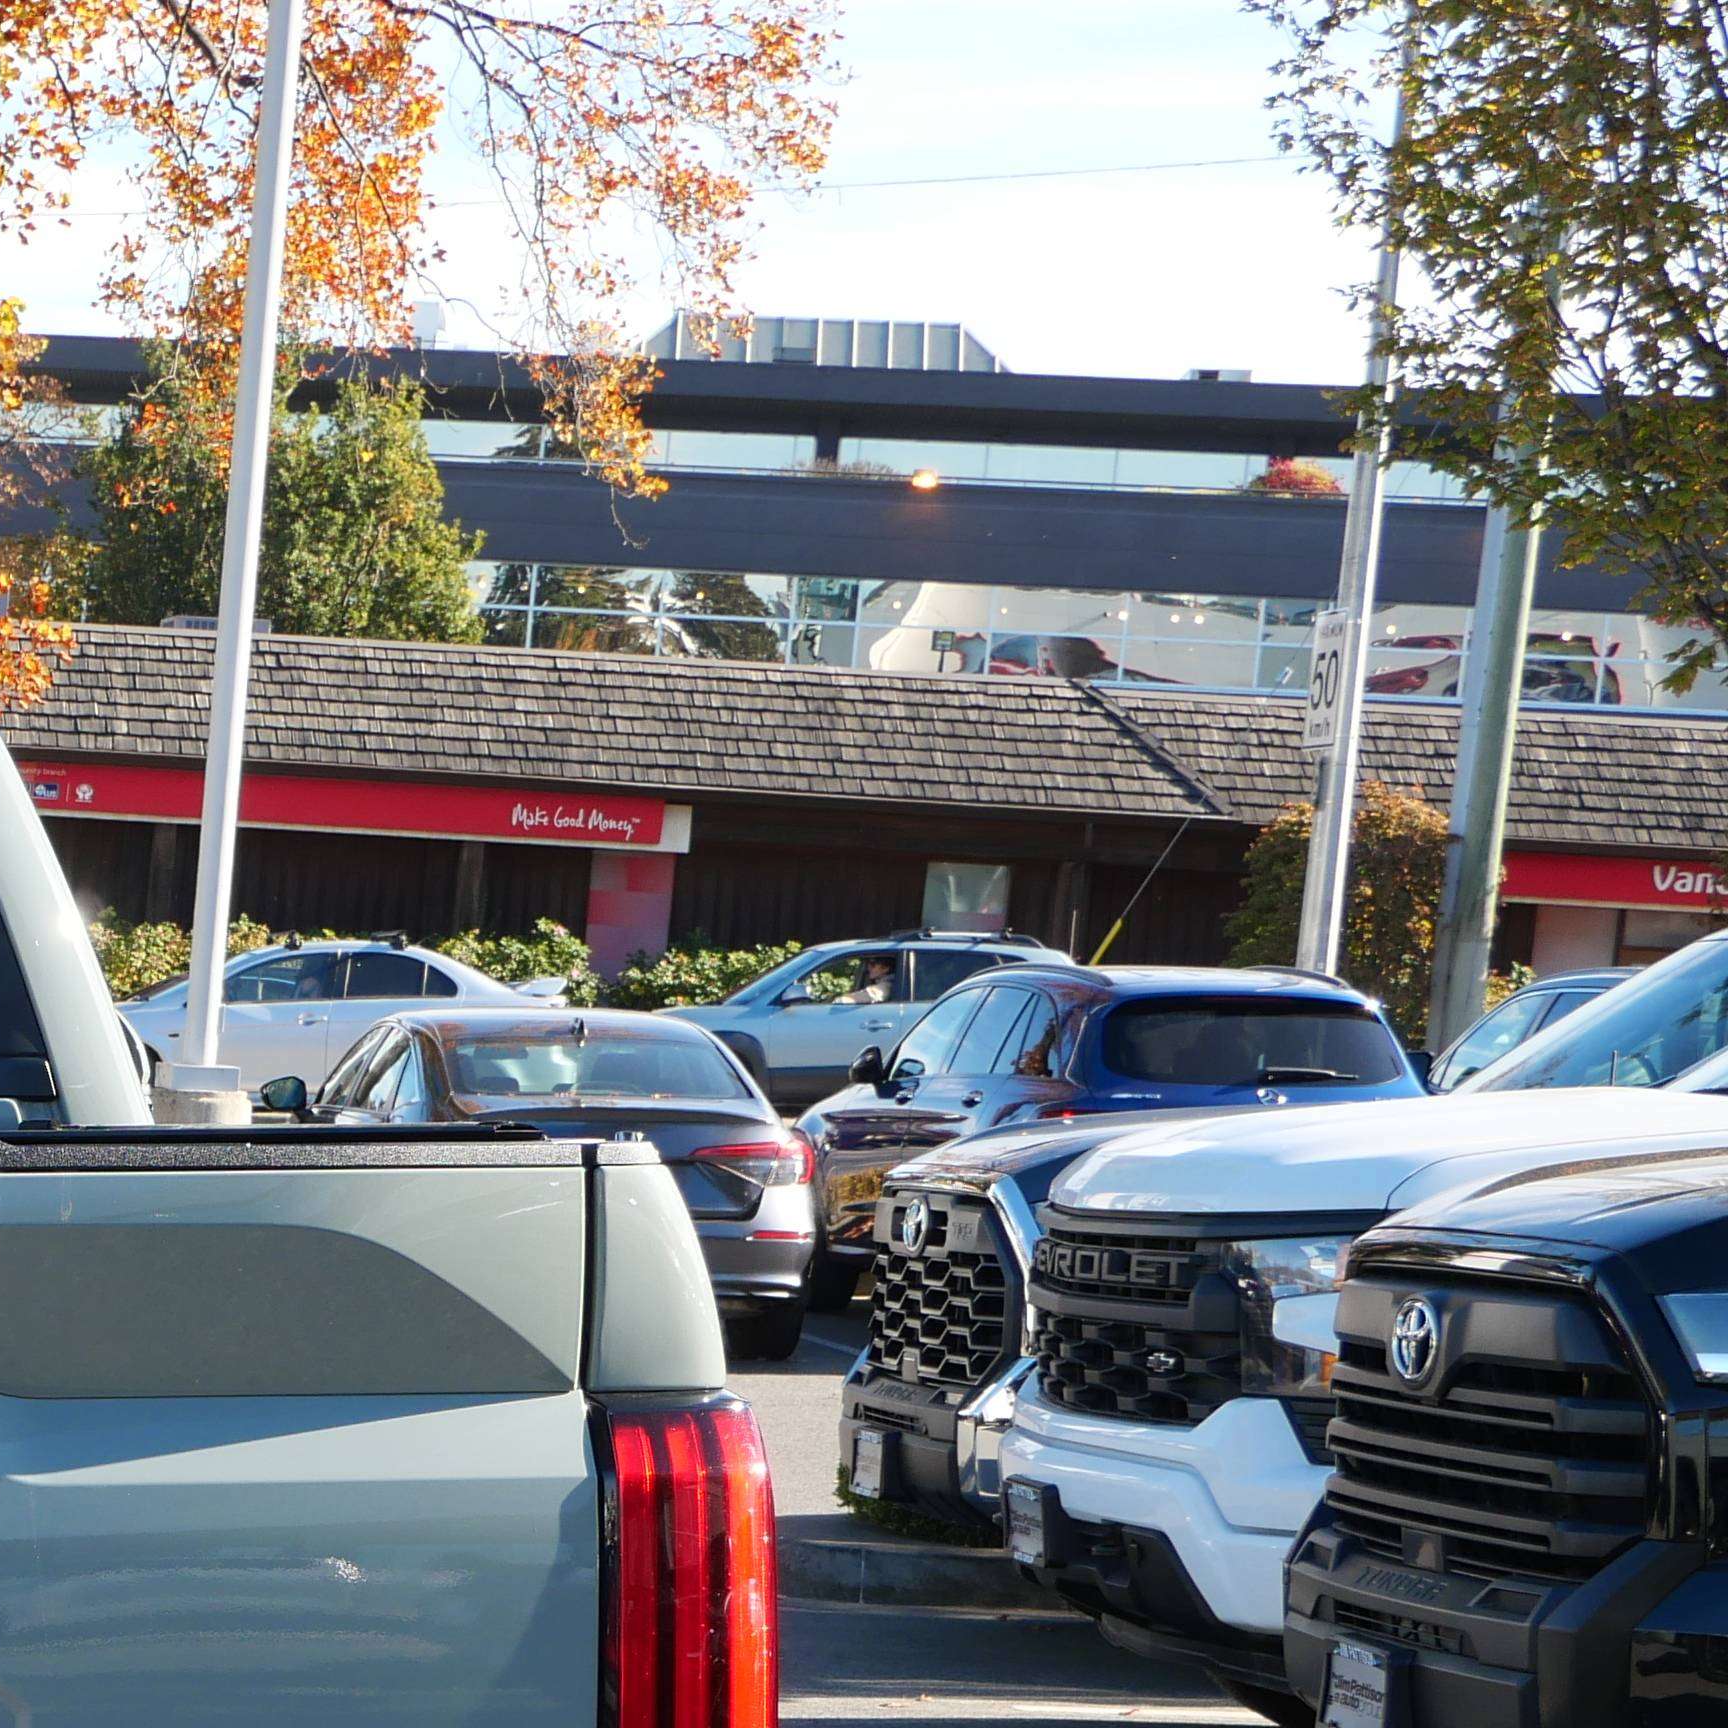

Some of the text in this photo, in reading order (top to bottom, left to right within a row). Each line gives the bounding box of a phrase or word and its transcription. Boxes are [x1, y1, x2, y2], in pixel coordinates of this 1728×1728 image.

[1311, 650, 1339, 711] 50
[511, 803, 550, 831] Make
[554, 806, 586, 828] Good
[1035, 1241, 1190, 1286] EVROLET
